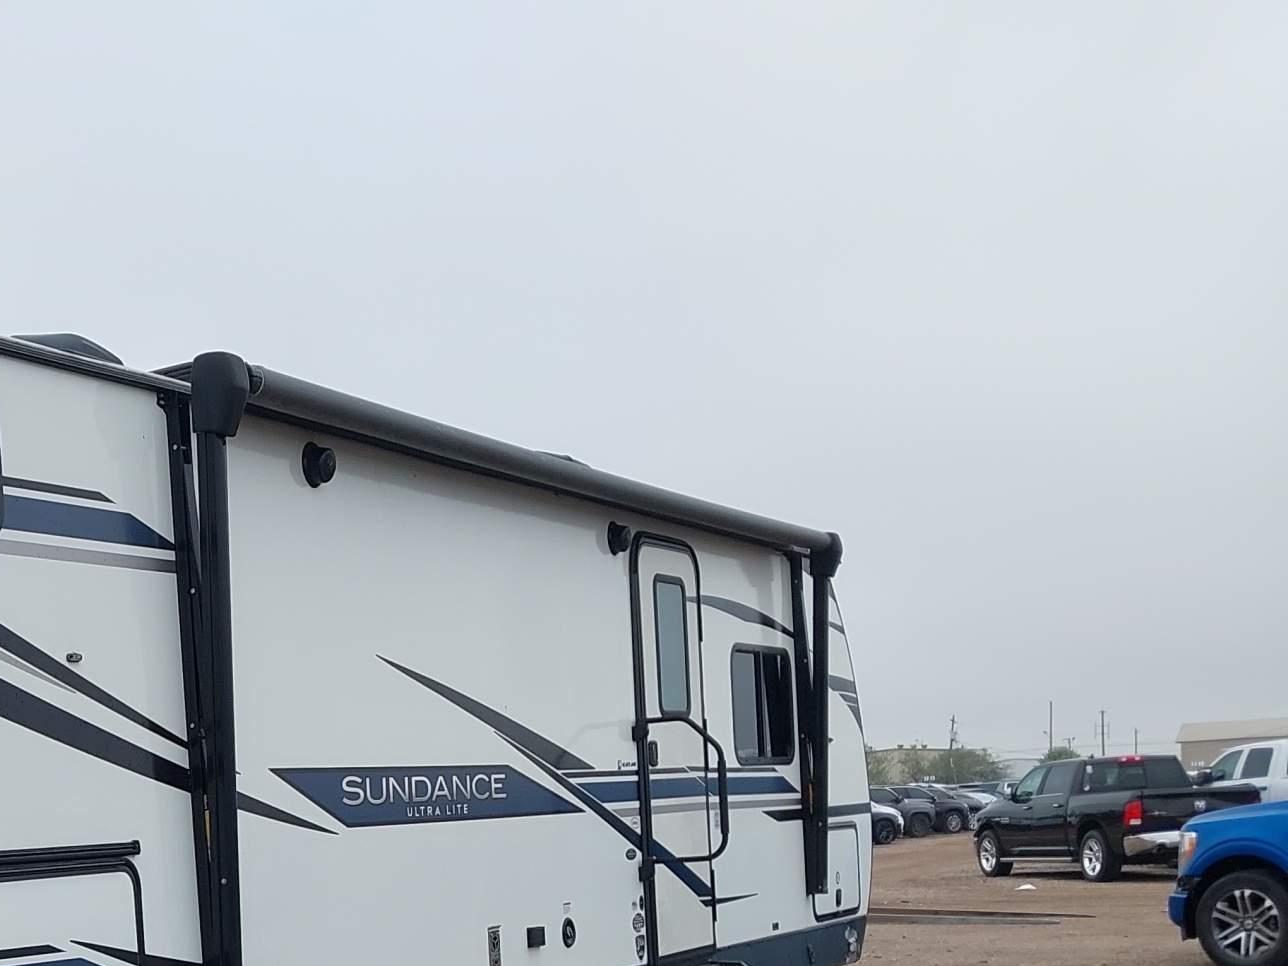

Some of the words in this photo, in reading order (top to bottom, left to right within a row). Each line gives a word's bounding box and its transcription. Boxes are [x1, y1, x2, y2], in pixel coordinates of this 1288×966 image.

[342, 774, 507, 806] SUNDANCE
[407, 805, 442, 817] ULTRA
[446, 803, 469, 816] LITE
